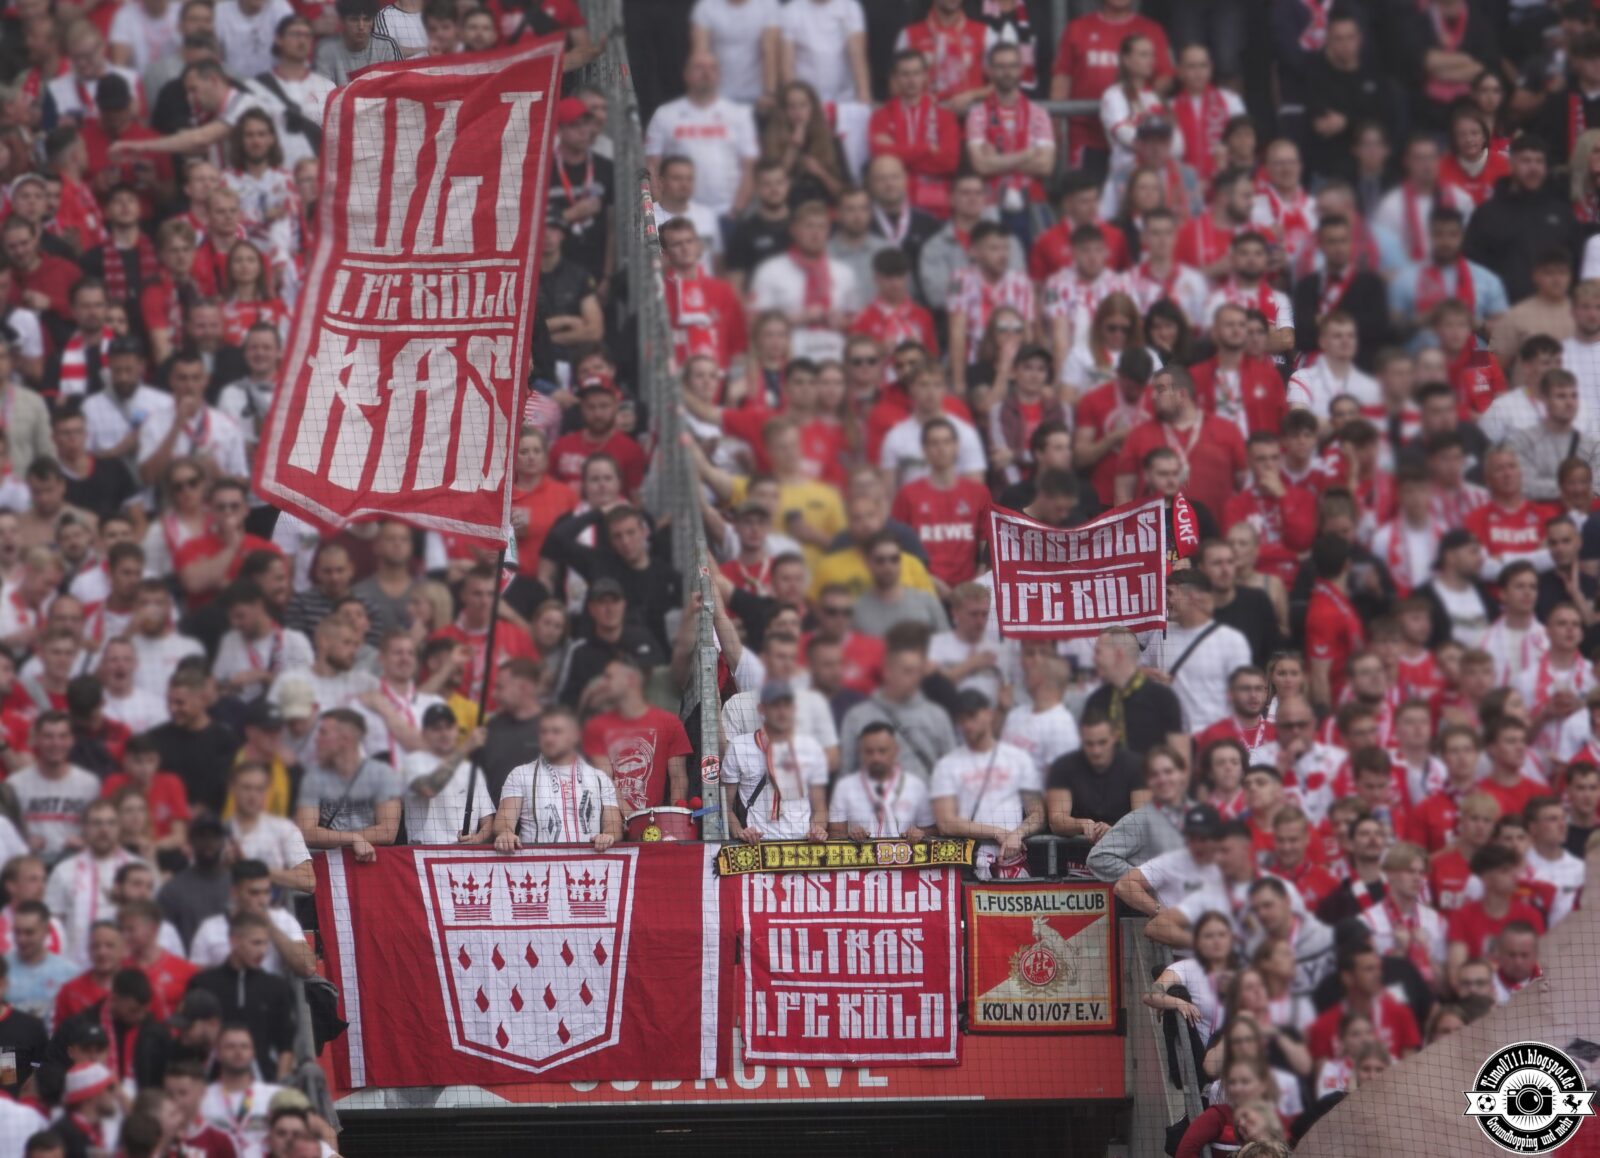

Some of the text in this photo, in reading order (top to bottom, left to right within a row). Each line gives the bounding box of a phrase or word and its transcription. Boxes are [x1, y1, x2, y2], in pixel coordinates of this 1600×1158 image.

[346, 91, 543, 255] ULT
[327, 269, 517, 320] 1.FC KÖLN
[287, 325, 513, 492] RAS
[920, 523, 975, 542] REWE
[998, 512, 1157, 563] RASCALS
[1001, 573, 1157, 622] 1.FC KÖLN
[765, 842, 928, 867] DESPERADOS
[751, 869, 943, 913] RASCALS
[975, 893, 1105, 912] 1.FUSSBALL-CLUB
[768, 928, 924, 974] ULTRAS
[756, 989, 945, 1039] 1.FC KÖLN
[983, 1003, 1103, 1021] KÖLN 01/07 E.V.
